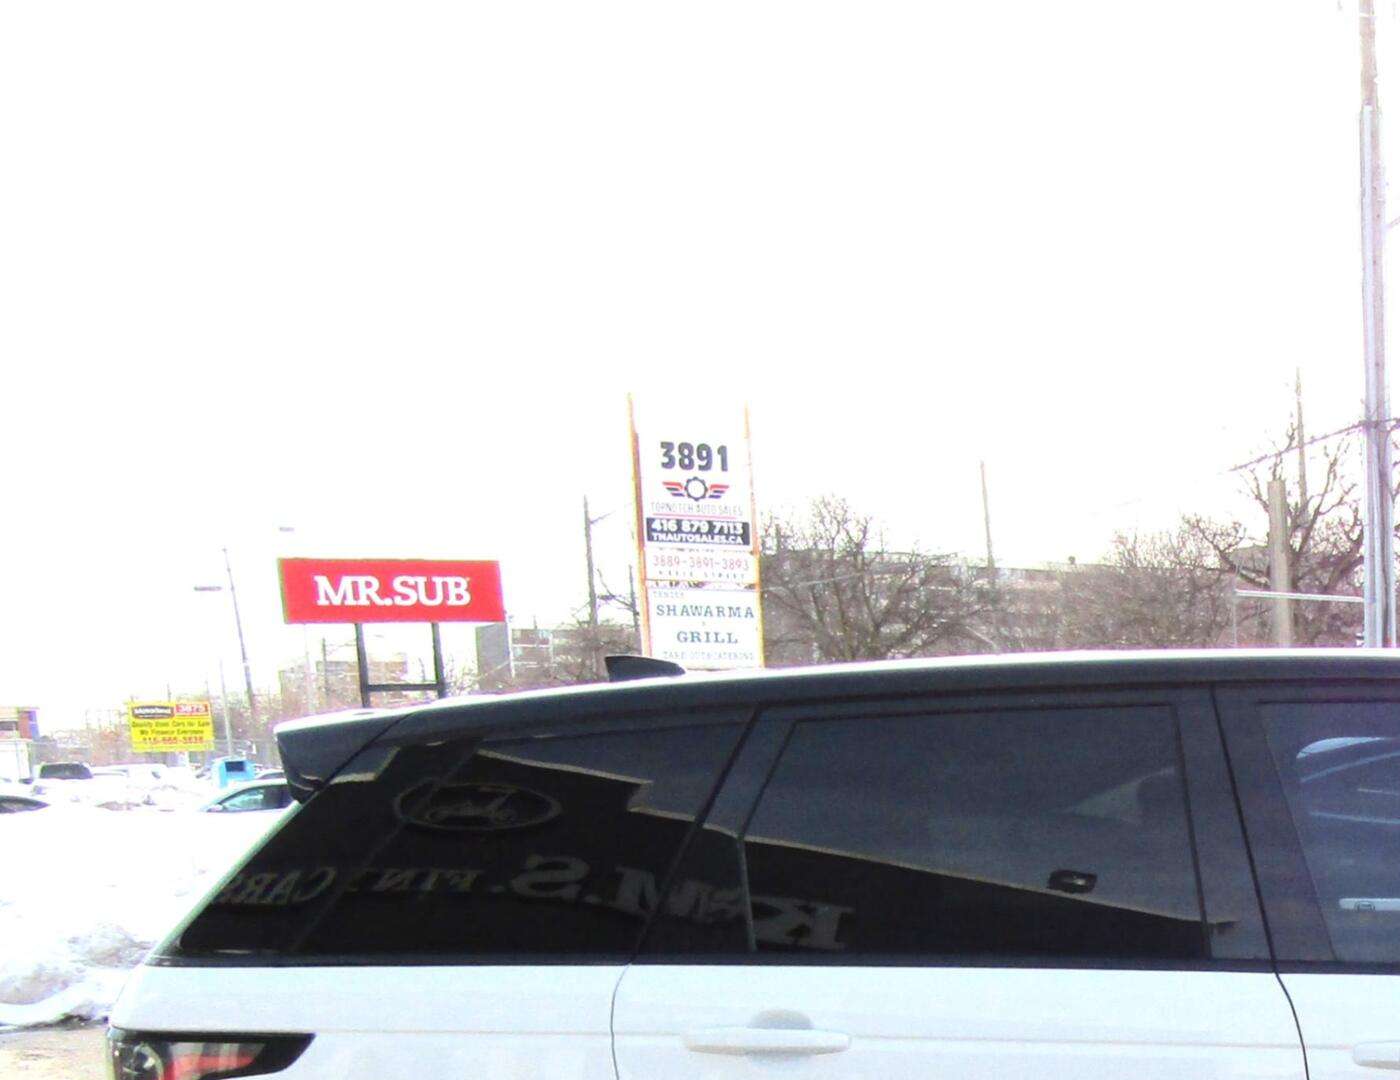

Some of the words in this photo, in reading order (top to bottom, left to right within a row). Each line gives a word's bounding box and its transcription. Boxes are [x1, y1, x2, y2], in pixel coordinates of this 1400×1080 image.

[660, 441, 728, 472] 3891
[651, 518, 678, 532] 416
[681, 520, 709, 533] 879
[713, 521, 743, 535] 7113
[651, 532, 743, 545] TNAUTOSALES.CA
[653, 554, 750, 571] 3889-3891-3893
[313, 575, 471, 607] MR.SUB
[656, 604, 755, 619] SHAWARMA
[676, 630, 738, 645] GRILL
